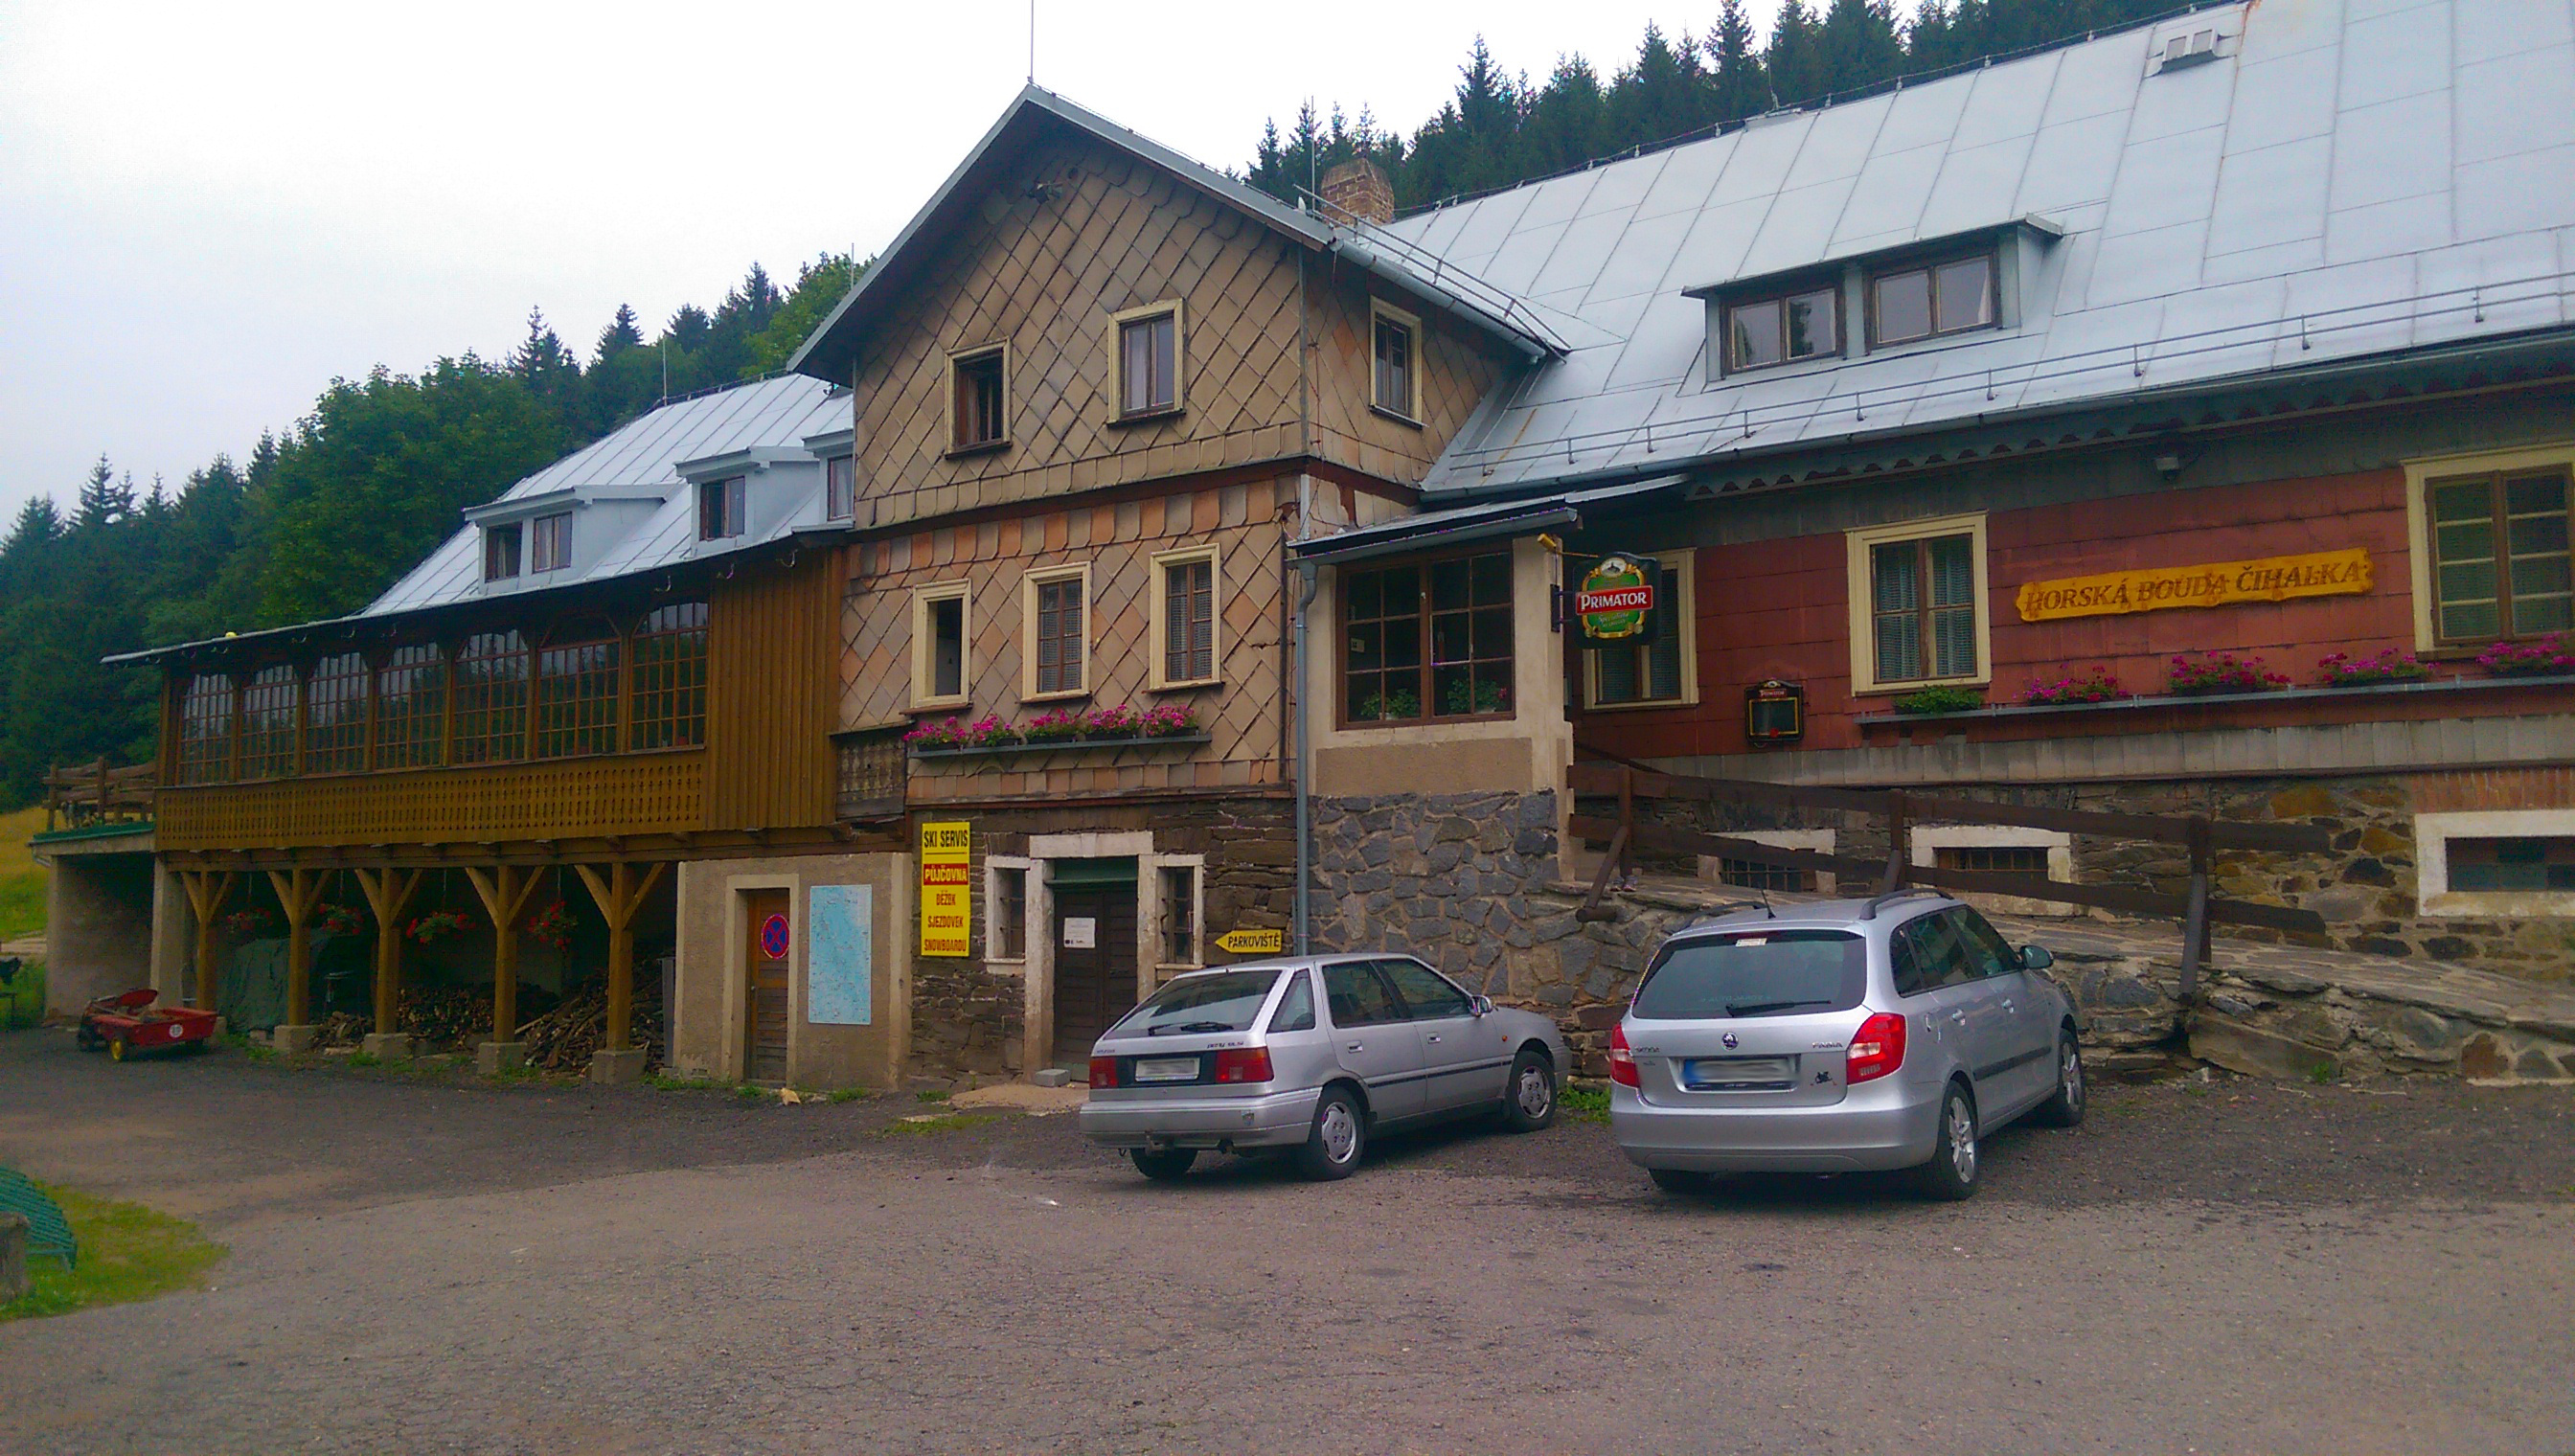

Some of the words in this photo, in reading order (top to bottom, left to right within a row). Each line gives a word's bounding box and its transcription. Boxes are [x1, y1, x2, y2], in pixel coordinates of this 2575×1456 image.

[2024, 578, 2130, 612] HORSKÁ
[2136, 573, 2228, 603] BOUDA
[2236, 560, 2360, 592] ČIHALKA
[1581, 592, 1647, 612] PRIMATOR
[923, 830, 938, 848] SKI
[940, 830, 968, 848] SERVIS
[924, 864, 968, 882] PŮJČOVNA
[927, 916, 964, 928] SJEZDOVEK
